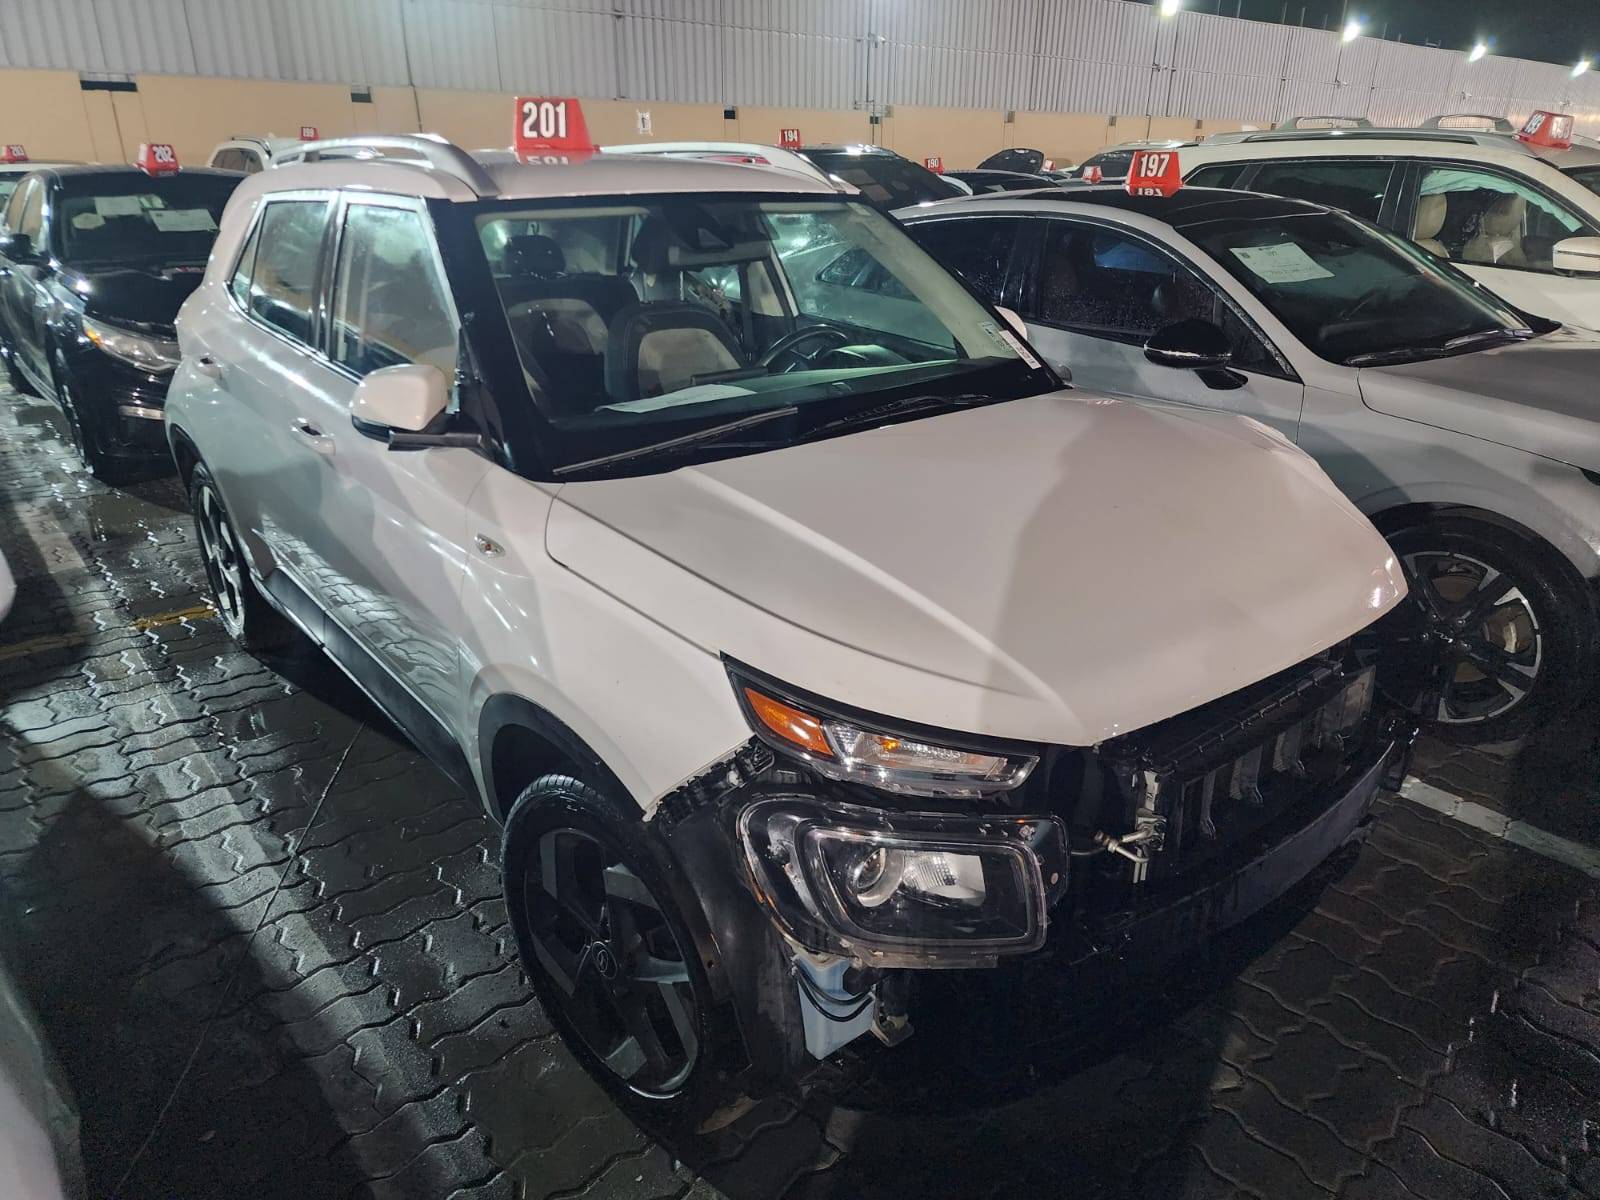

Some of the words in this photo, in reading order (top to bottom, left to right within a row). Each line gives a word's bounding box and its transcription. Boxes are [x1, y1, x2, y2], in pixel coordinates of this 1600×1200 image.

[522, 101, 567, 139] 201
[784, 130, 798, 143] 194
[152, 145, 175, 163] 202
[928, 158, 939, 169] 190
[1139, 154, 1169, 178] 197
